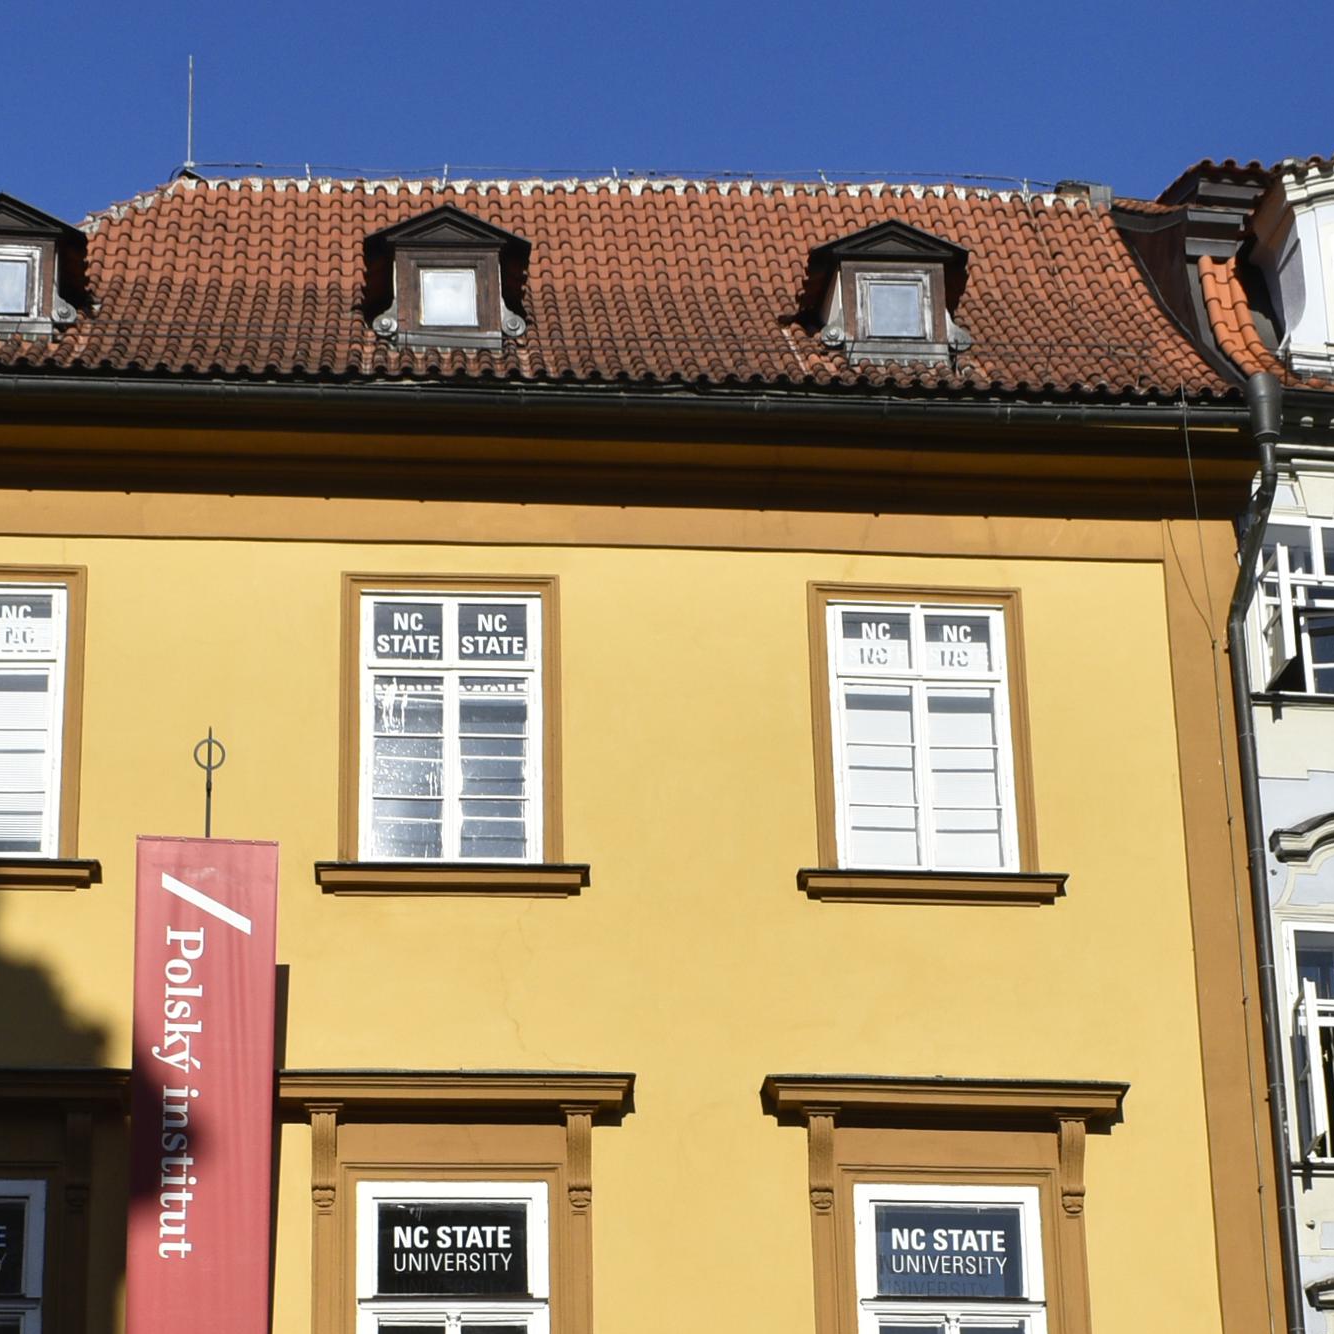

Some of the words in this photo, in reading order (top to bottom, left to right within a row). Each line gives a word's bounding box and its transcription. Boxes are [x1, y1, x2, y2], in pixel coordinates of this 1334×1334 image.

[1, 605, 32, 620] NC
[393, 612, 423, 631] NC
[477, 614, 508, 632] NC
[861, 622, 891, 640] NC
[376, 634, 440, 653] STATE
[942, 625, 972, 643] NC
[461, 635, 524, 654] STATE
[151, 925, 205, 1073] Polský
[157, 1085, 200, 1259] institut
[393, 1226, 429, 1248] NC
[436, 1226, 512, 1248] STATE
[891, 1228, 926, 1250] NC
[933, 1228, 1006, 1252] STATE
[393, 1253, 512, 1272] UNIVERSITY
[892, 1254, 1007, 1275] UNIVERSITY
